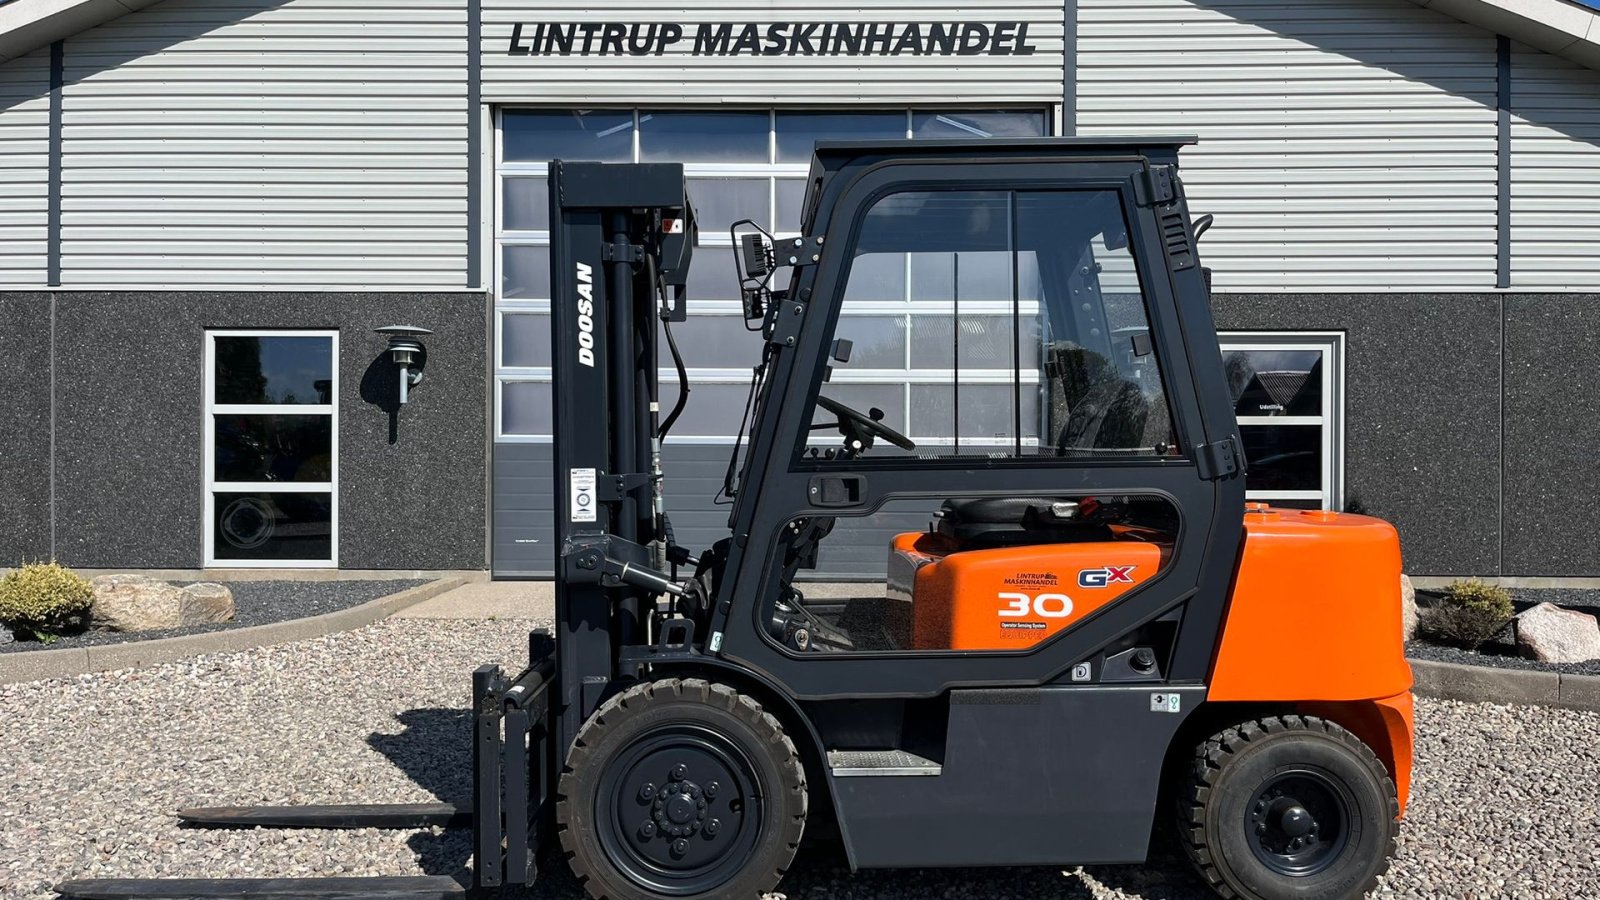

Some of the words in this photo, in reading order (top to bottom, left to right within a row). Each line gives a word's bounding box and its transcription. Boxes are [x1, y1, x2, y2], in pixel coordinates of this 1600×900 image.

[507, 22, 683, 56] LINTRUP
[692, 22, 1036, 56] MASKINHANDEL
[577, 262, 594, 367] DOOSAN
[1003, 578, 1058, 586] MASKINHANDEL
[1078, 565, 1137, 588] GX
[998, 592, 1074, 618] 30
